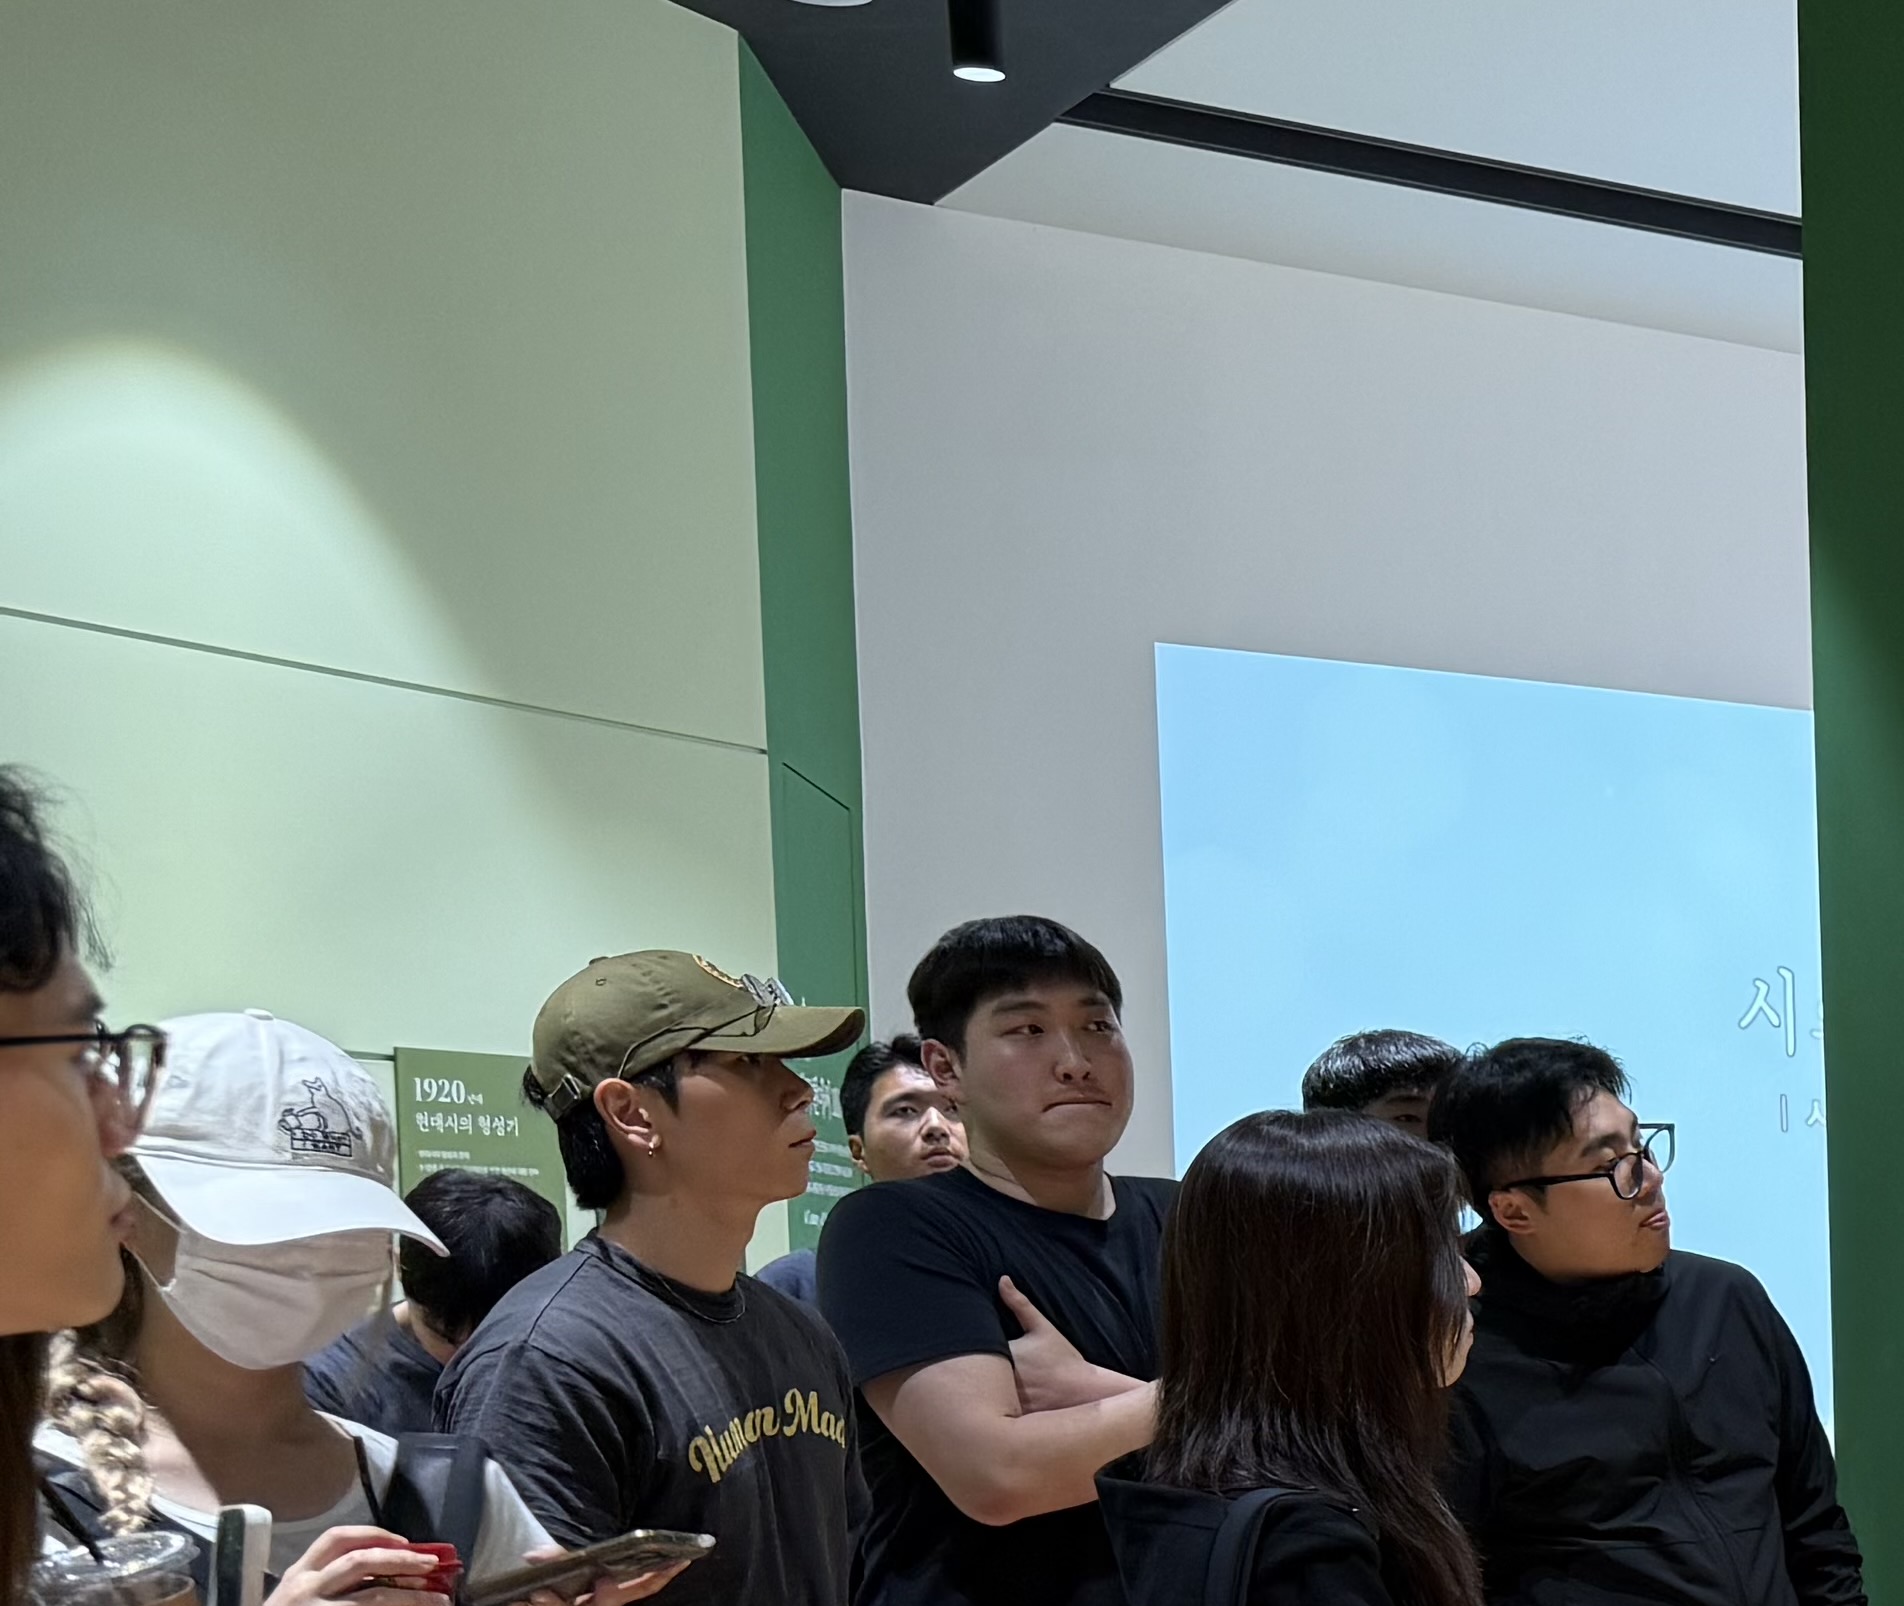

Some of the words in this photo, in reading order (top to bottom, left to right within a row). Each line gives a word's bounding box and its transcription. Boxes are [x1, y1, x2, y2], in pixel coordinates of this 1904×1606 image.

[415, 1111, 473, 1135] 현대시의
[478, 1114, 519, 1137] 형성기
[689, 1406, 781, 1483] Human
[782, 1388, 845, 1448] Mad
